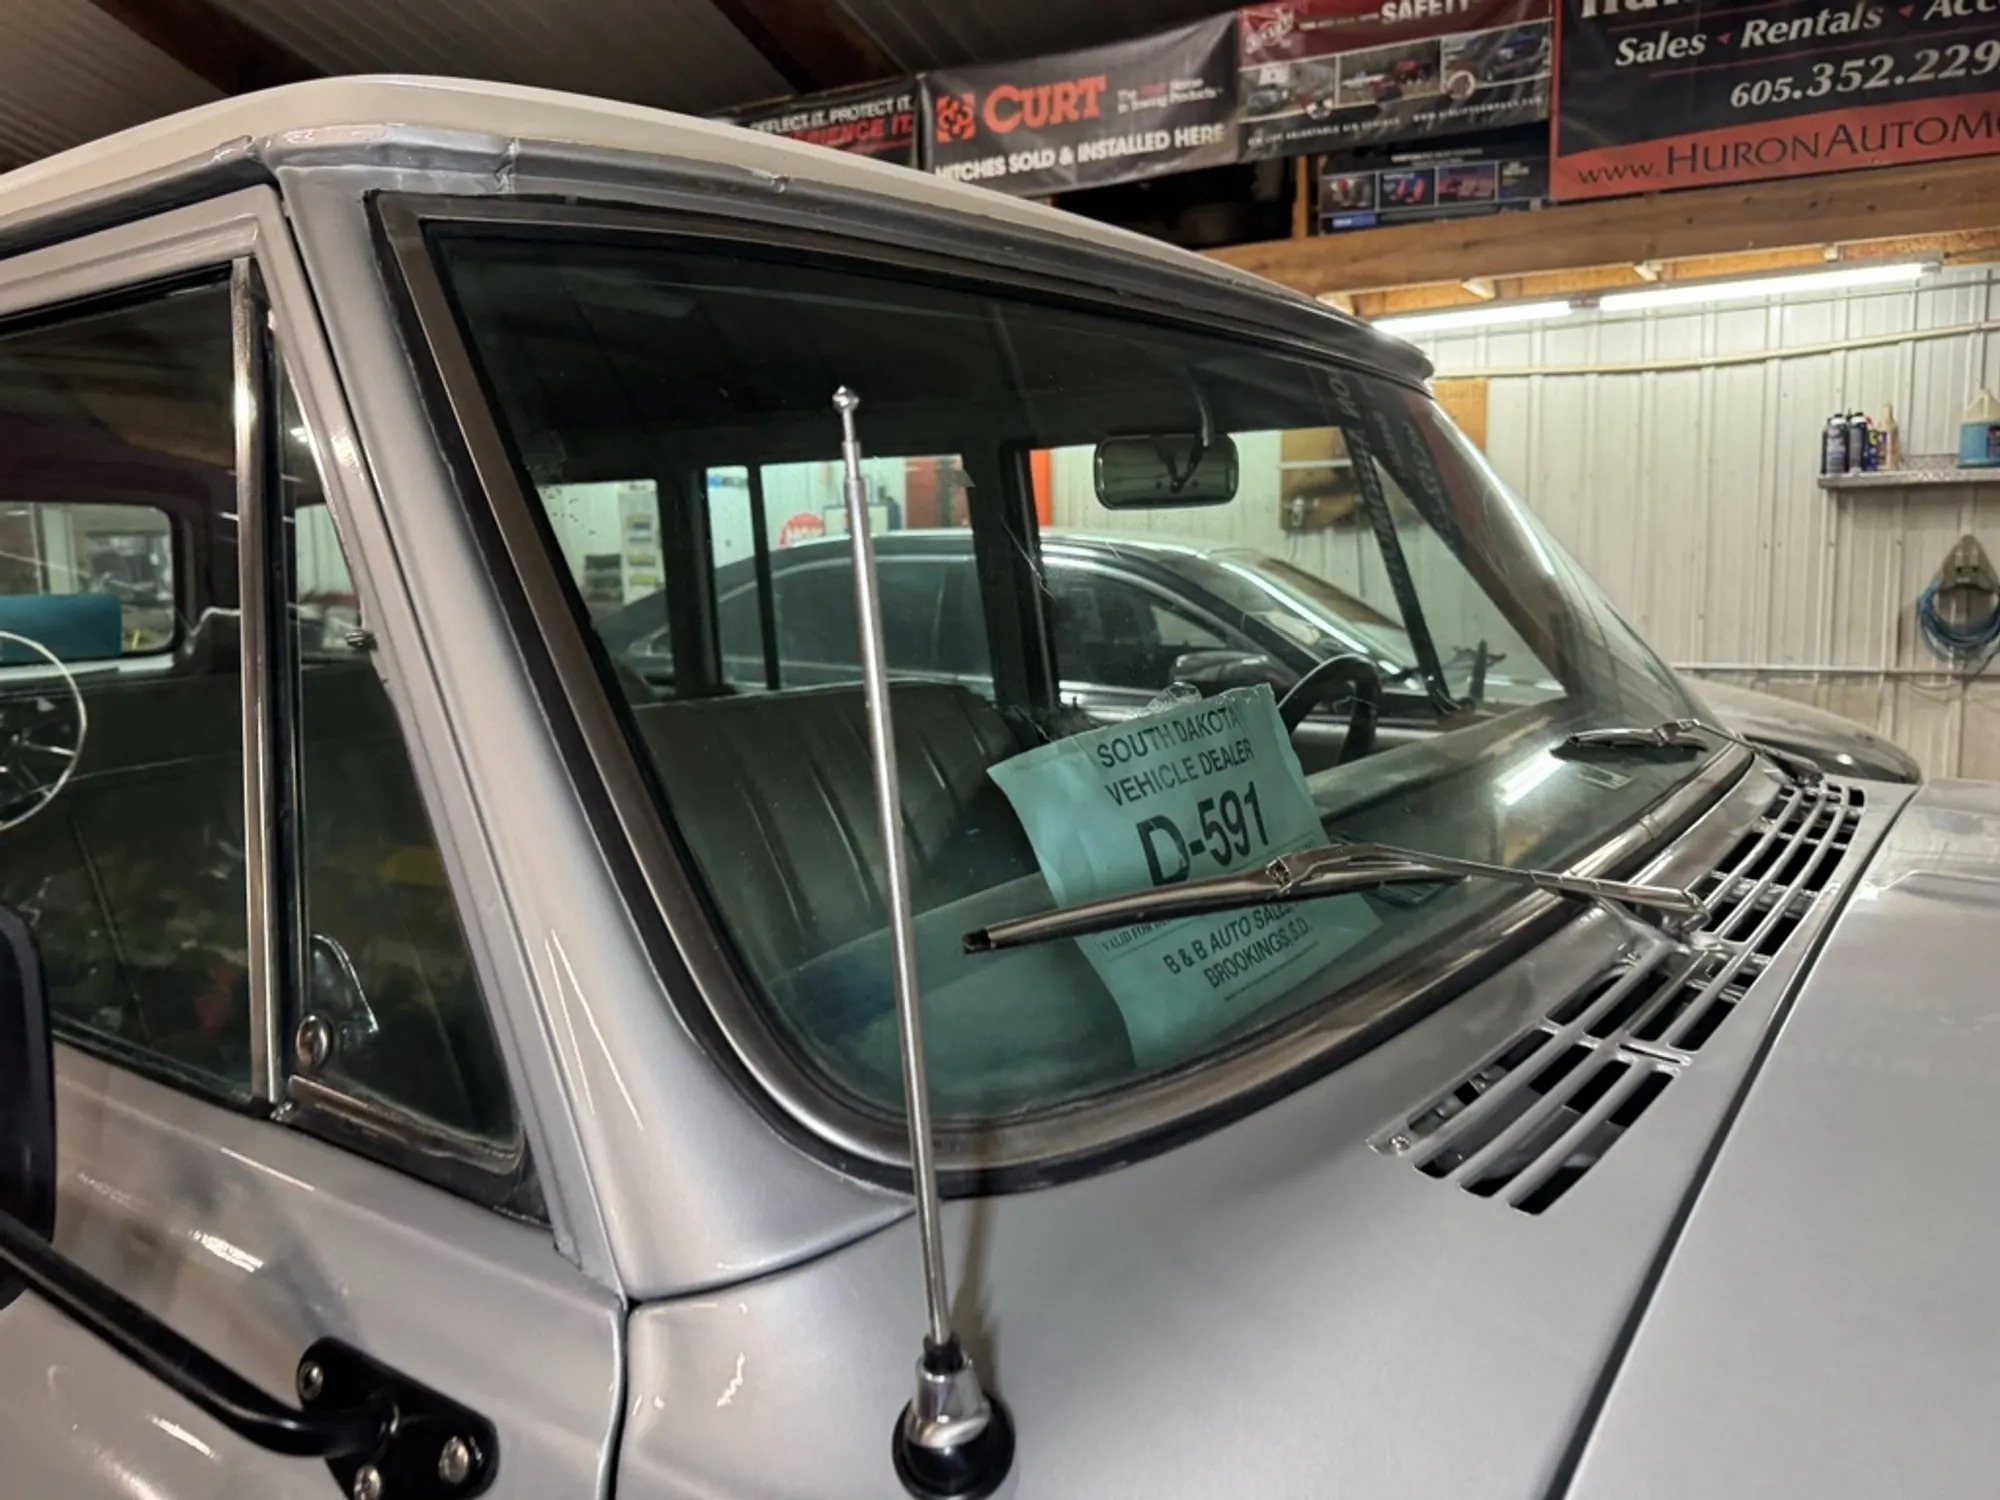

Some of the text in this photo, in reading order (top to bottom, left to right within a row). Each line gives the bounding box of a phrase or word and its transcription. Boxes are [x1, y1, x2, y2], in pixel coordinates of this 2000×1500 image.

[1615, 30, 1707, 66] Sales
[1740, 1, 1884, 48] Rentals
[829, 98, 894, 123] PROTECT
[984, 75, 1106, 133] CURT
[1008, 148, 1055, 173] SOLD
[1058, 144, 1076, 166] &
[1077, 129, 1171, 163] INSTALLED
[1174, 122, 1225, 148] HERE
[1578, 110, 2000, 185] www.HURONAUTOM
[1097, 706, 1245, 769] SOUTH DAKOTA
[1104, 738, 1256, 807] VEHICLE DEALER
[1136, 780, 1269, 887] D-591
[1163, 954, 1181, 976] B
[1178, 948, 1194, 968] &
[1191, 939, 1208, 961] B
[1210, 916, 1252, 954] AUTO
